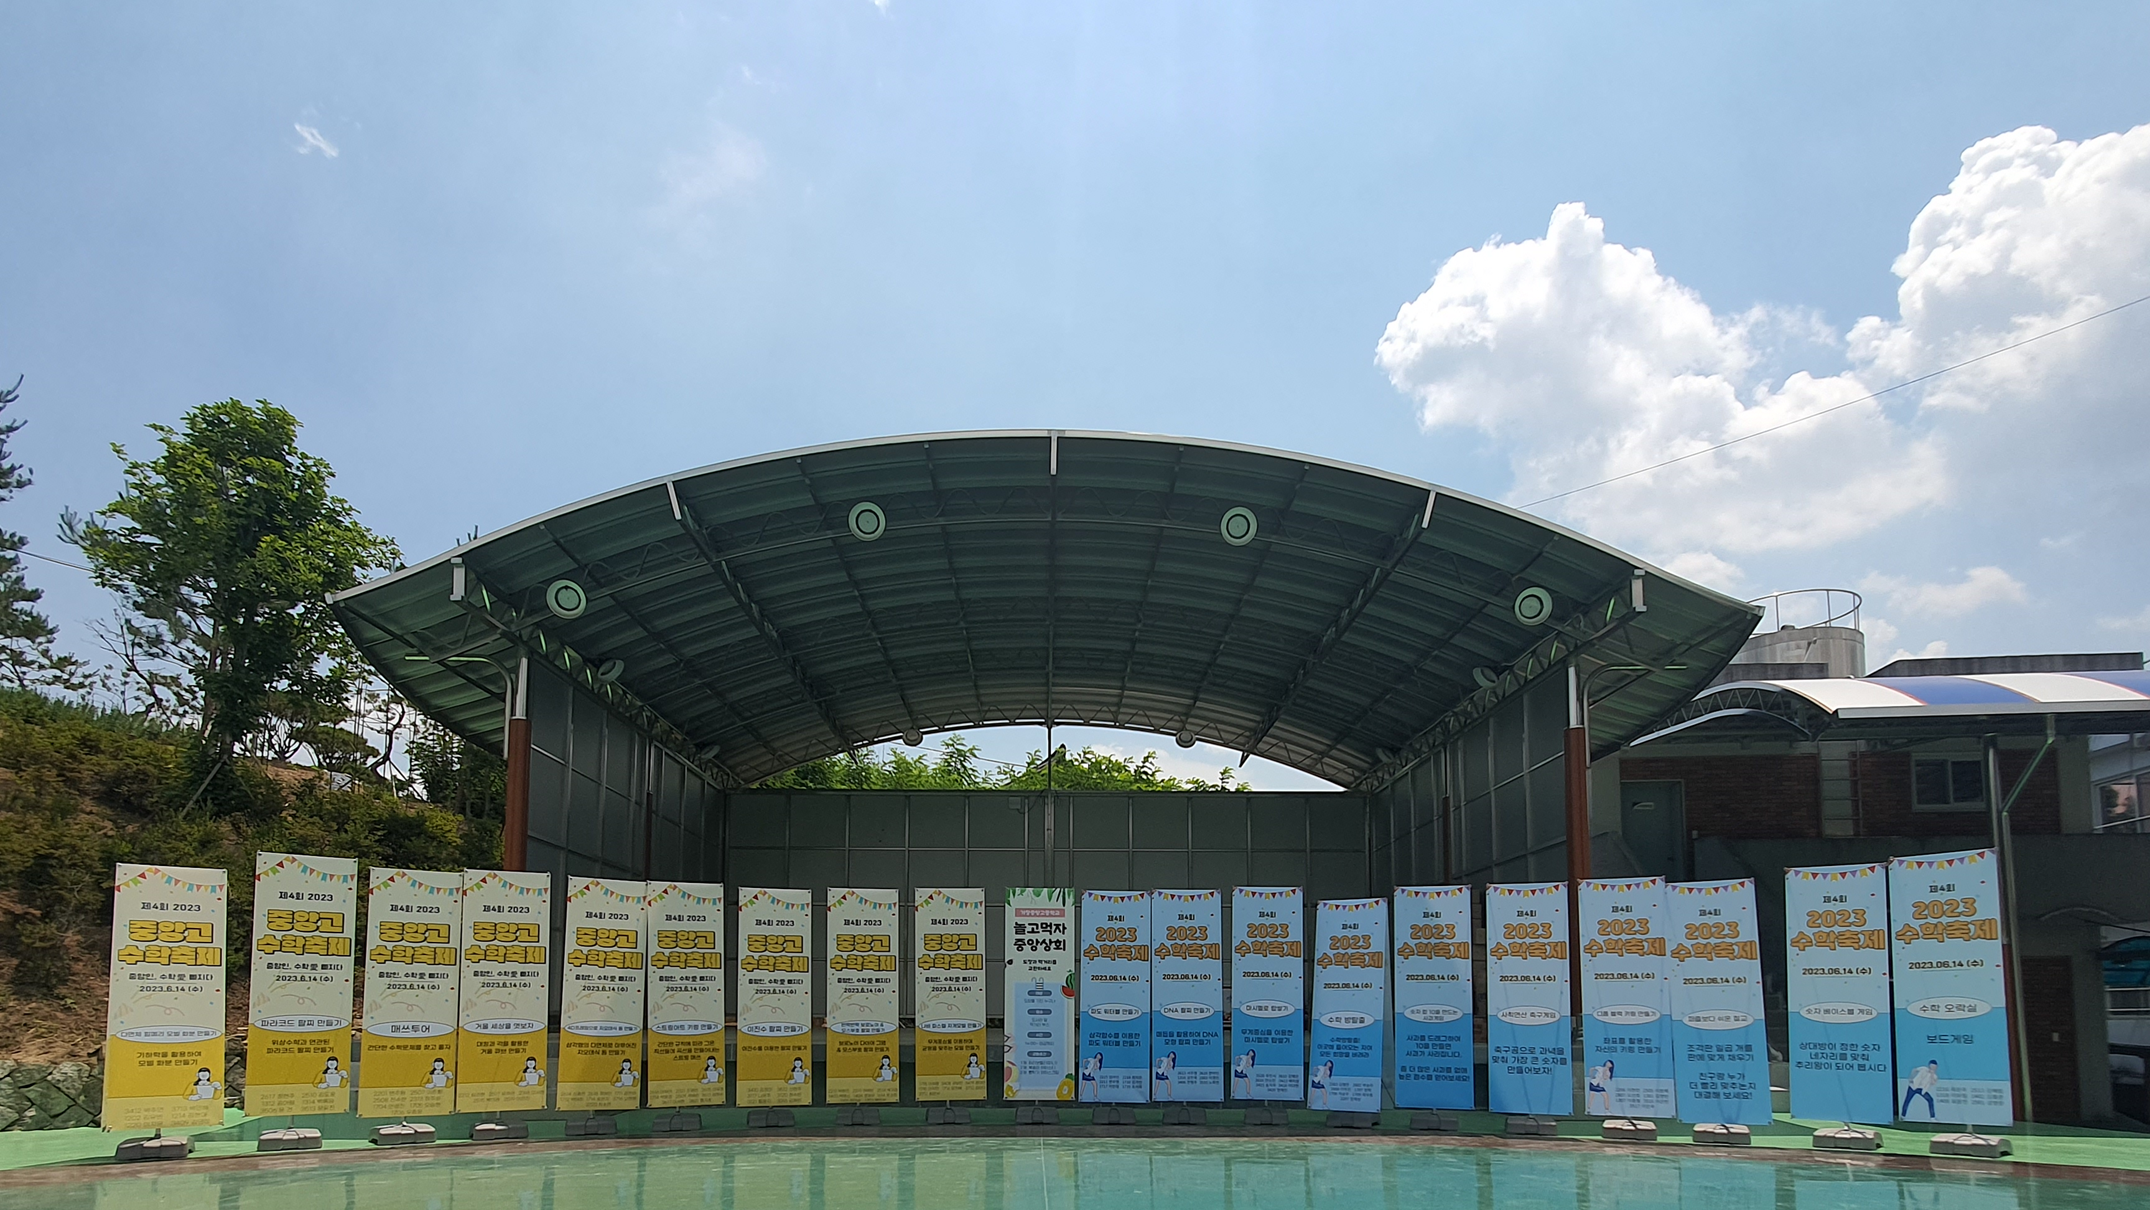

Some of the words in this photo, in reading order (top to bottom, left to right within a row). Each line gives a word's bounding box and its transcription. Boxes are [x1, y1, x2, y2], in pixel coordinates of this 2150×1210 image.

[279, 891, 304, 900] 제4회
[308, 893, 333, 901] 2023
[1929, 884, 1955, 893] 제4회
[141, 902, 168, 911] 제4회
[1823, 895, 1847, 903] 제4회
[390, 904, 413, 912] 제4회
[586, 911, 605, 919] 제4회
[1912, 898, 1976, 919] 2023
[267, 909, 344, 933] 중앙고
[1598, 918, 1649, 935] 2023
[1807, 909, 1866, 928] 2023
[129, 920, 213, 943] 중앙고
[379, 921, 450, 944] 중앙고
[473, 921, 539, 943] 중앙고
[1014, 922, 1067, 935] 놀고먹자
[1096, 927, 1137, 942] 2023
[1166, 926, 1208, 940] 2023
[1247, 924, 1289, 938] 2023
[1410, 924, 1456, 939] 2023
[1503, 923, 1552, 939] 2023
[1685, 922, 1739, 939] 2023
[1895, 919, 1998, 944] 수학축제
[257, 934, 351, 956] 수학축제
[576, 927, 638, 948] 중앙고
[657, 930, 715, 949] 중앙고
[748, 934, 803, 953] 중앙고
[836, 934, 890, 952] 중앙고
[924, 933, 977, 951] 중앙고
[1014, 938, 1066, 951] 중앙상회
[1329, 935, 1371, 950] 2023
[1791, 929, 1886, 951] 수학축제
[118, 945, 222, 966] 수학축제
[370, 945, 457, 966] 수학축제
[465, 944, 546, 964] 수학축제
[1084, 944, 1149, 962] 수학축제
[1154, 943, 1220, 960] 수학축제
[1235, 940, 1301, 957] 수학축제
[1398, 942, 1469, 960] 수학축제
[1490, 941, 1567, 960] 수학축제
[1584, 937, 1666, 957] 수학축제
[1671, 941, 1757, 962] 수학축제
[568, 949, 643, 969] 수학축제
[651, 951, 721, 969] 수학축제
[741, 955, 808, 973] 수학축제
[830, 954, 896, 971] 수학축제
[918, 953, 983, 970] 수학축제
[1317, 952, 1383, 969] 수학축제
[1909, 961, 1963, 969] 2023.06.14
[1967, 960, 1984, 968] (수)
[1920, 1005, 1940, 1013] 수학
[1945, 1004, 1977, 1013] 오락실
[391, 1025, 430, 1033] 매쓰투어
[1799, 1042, 1836, 1050] 상대방이
[1927, 1035, 1974, 1044] 보드게임
[1542, 1057, 1567, 1065] 숫자를
[1810, 1052, 1847, 1060] 네자리를
[1835, 1062, 1854, 1070] 되어
